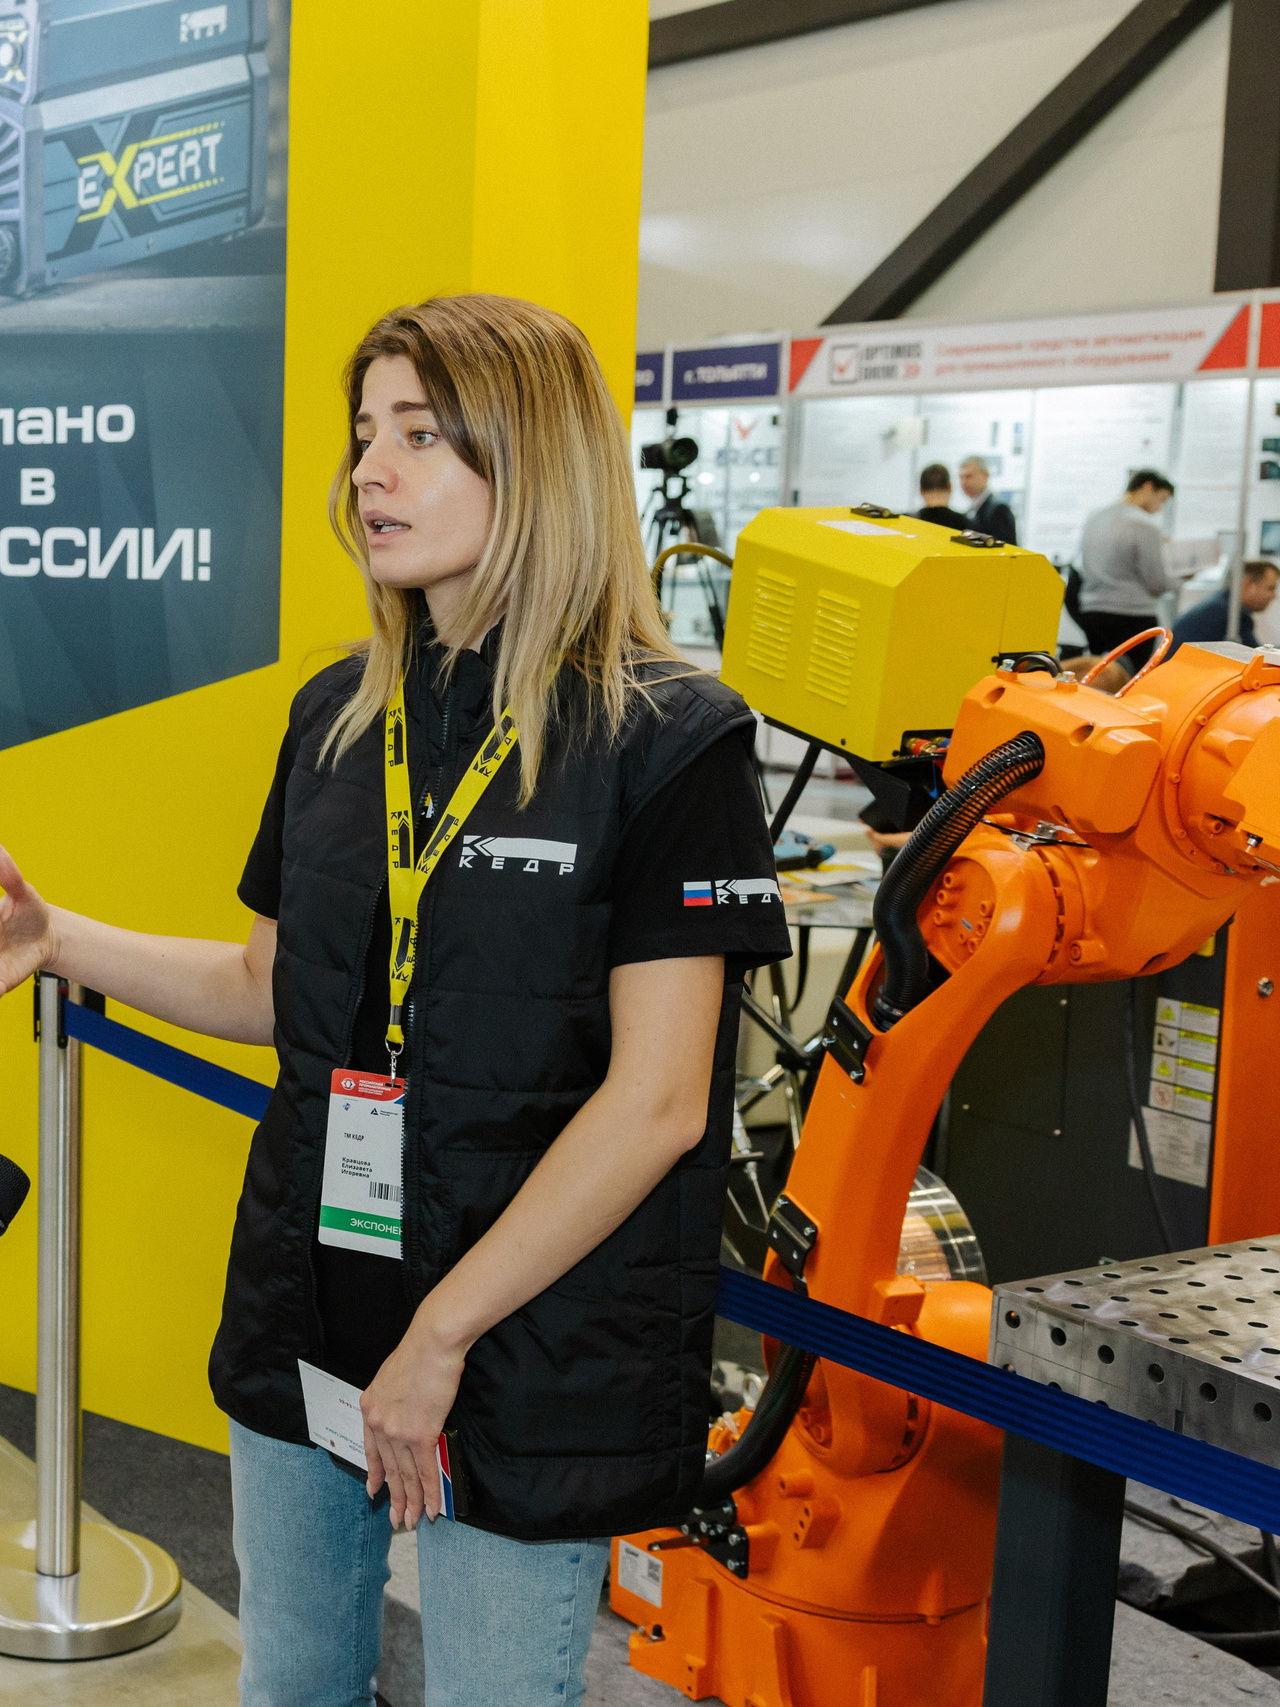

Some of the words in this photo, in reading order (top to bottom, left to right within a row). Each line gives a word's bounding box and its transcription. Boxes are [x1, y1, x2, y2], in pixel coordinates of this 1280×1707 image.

[76, 132, 224, 216] EXPERT
[482, 736, 512, 778] КЕД
[390, 811, 400, 869] КЕДР
[422, 817, 461, 875] КЕДР
[458, 855, 576, 876] КЕДР
[340, 1168, 370, 1179] Игоревна
[341, 1156, 371, 1166] Кравцова
[341, 1162, 373, 1173] Елизавета
